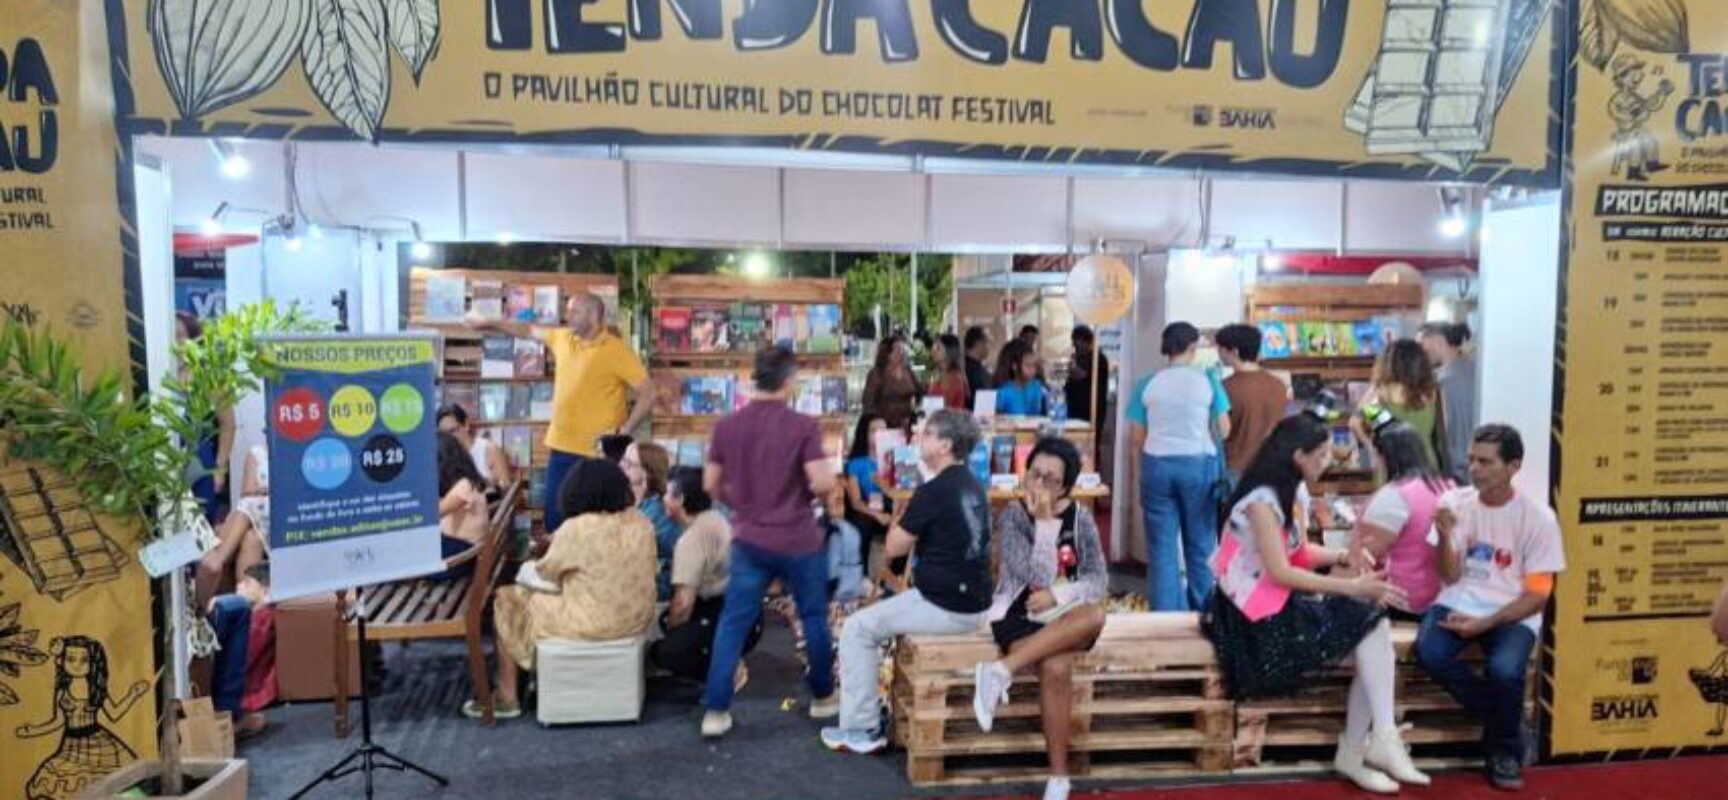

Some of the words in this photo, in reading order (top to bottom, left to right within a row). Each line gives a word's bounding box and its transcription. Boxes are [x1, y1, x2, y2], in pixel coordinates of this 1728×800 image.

[1676, 54, 1728, 98] TE
[484, 72, 501, 98] O
[512, 71, 640, 106] PAVILHÃO
[648, 82, 770, 114] CULTURAL
[778, 87, 813, 115] DO
[822, 90, 944, 121] CHOCOLAT
[951, 96, 1057, 126] FESTIVAL
[1675, 100, 1728, 140] CA
[276, 346, 351, 363] NOSSOS
[355, 345, 418, 365] PREÇOS
[280, 407, 304, 424] R$
[308, 403, 321, 420] 5
[332, 402, 351, 418] R$
[357, 400, 374, 415] 10
[362, 451, 383, 467] R$
